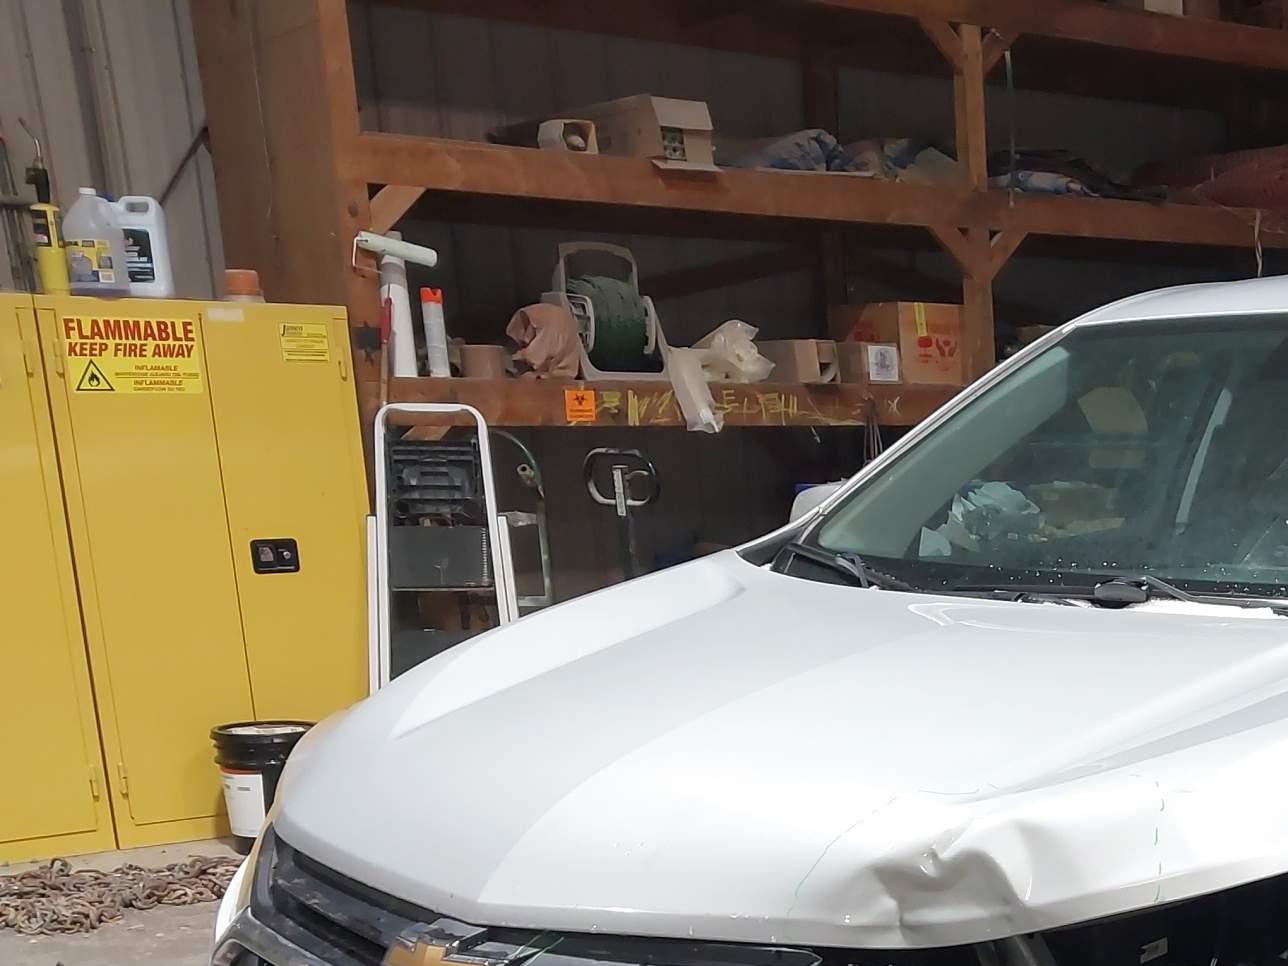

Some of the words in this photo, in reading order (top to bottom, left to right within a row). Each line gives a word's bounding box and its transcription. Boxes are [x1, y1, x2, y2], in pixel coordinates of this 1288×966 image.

[63, 317, 195, 342] FLAMMABLE
[68, 342, 109, 357] KEEP
[114, 342, 147, 358] FIRE
[152, 343, 194, 358] AWAY
